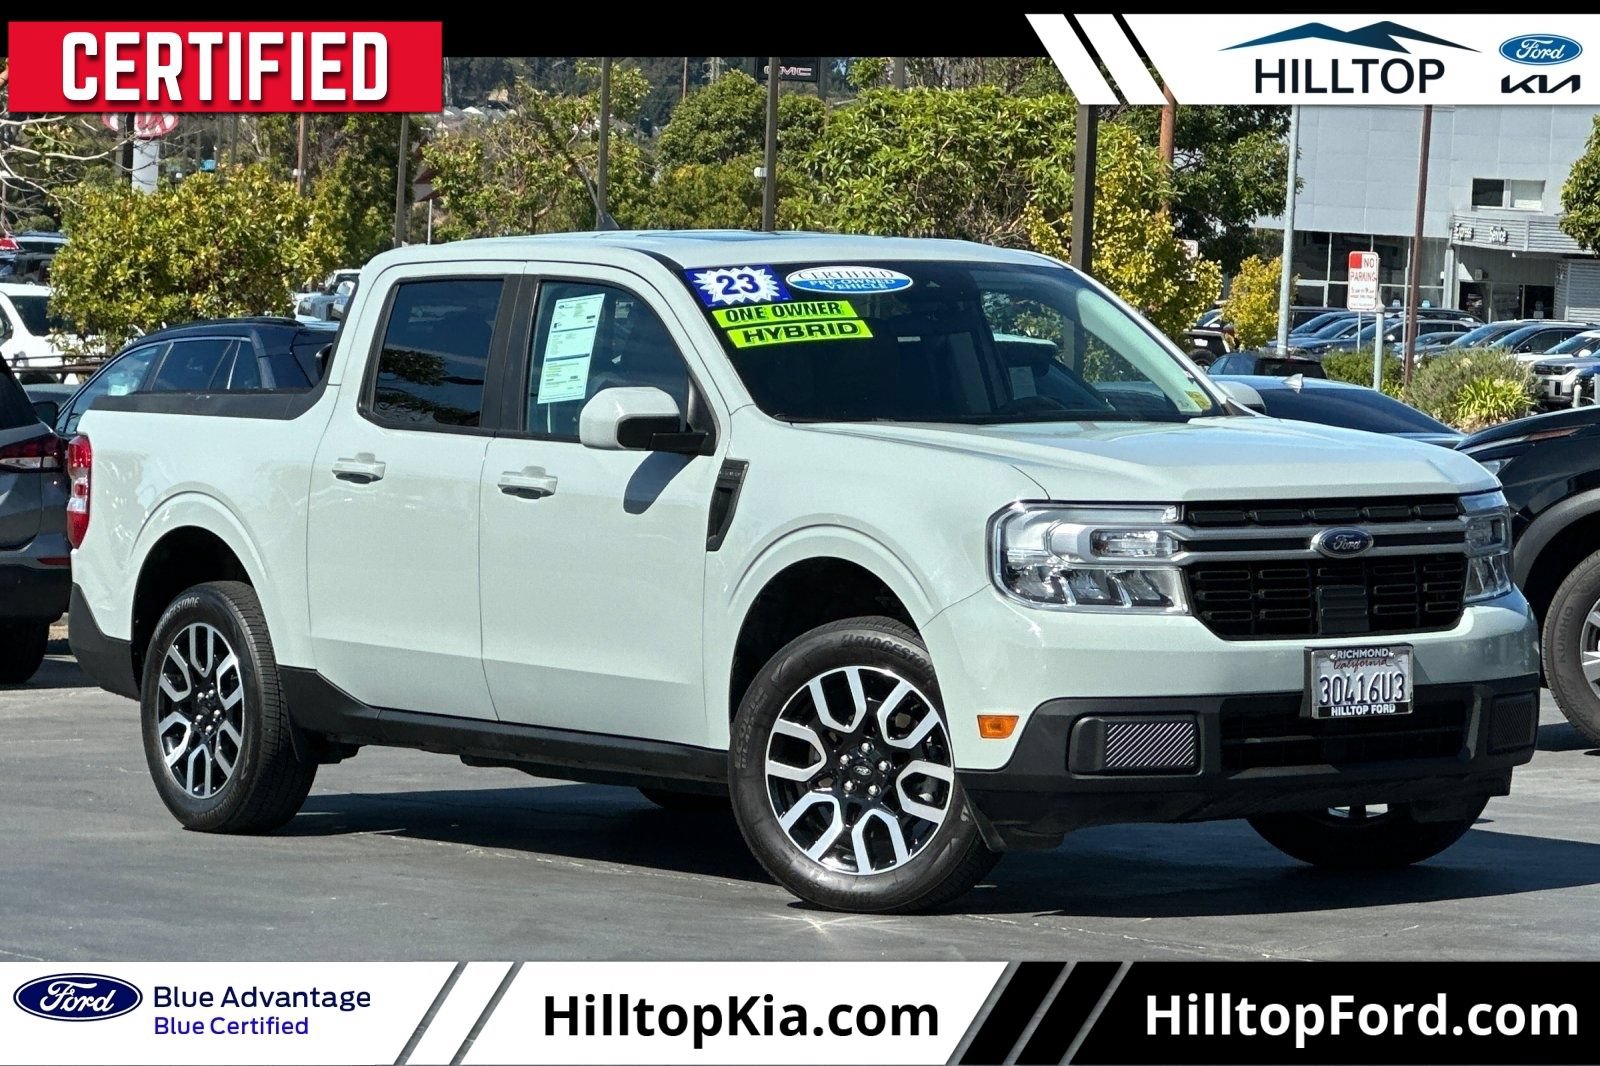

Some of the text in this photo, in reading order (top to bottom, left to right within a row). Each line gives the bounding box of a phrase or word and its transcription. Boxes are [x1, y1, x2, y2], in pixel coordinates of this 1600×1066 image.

[1363, 258, 1375, 268] NO
[798, 271, 895, 279] CERTIFIED
[1350, 271, 1377, 282] PARKING
[716, 273, 762, 295] 23
[725, 301, 843, 323] ONE OWNER
[742, 322, 860, 344] HYBRID
[1333, 535, 1361, 550] Ford
[1337, 648, 1390, 660] RICHMOND
[1334, 658, 1393, 673] California
[1320, 671, 1405, 705] 30416U3
[1331, 703, 1396, 716] HILLTOP FORD
